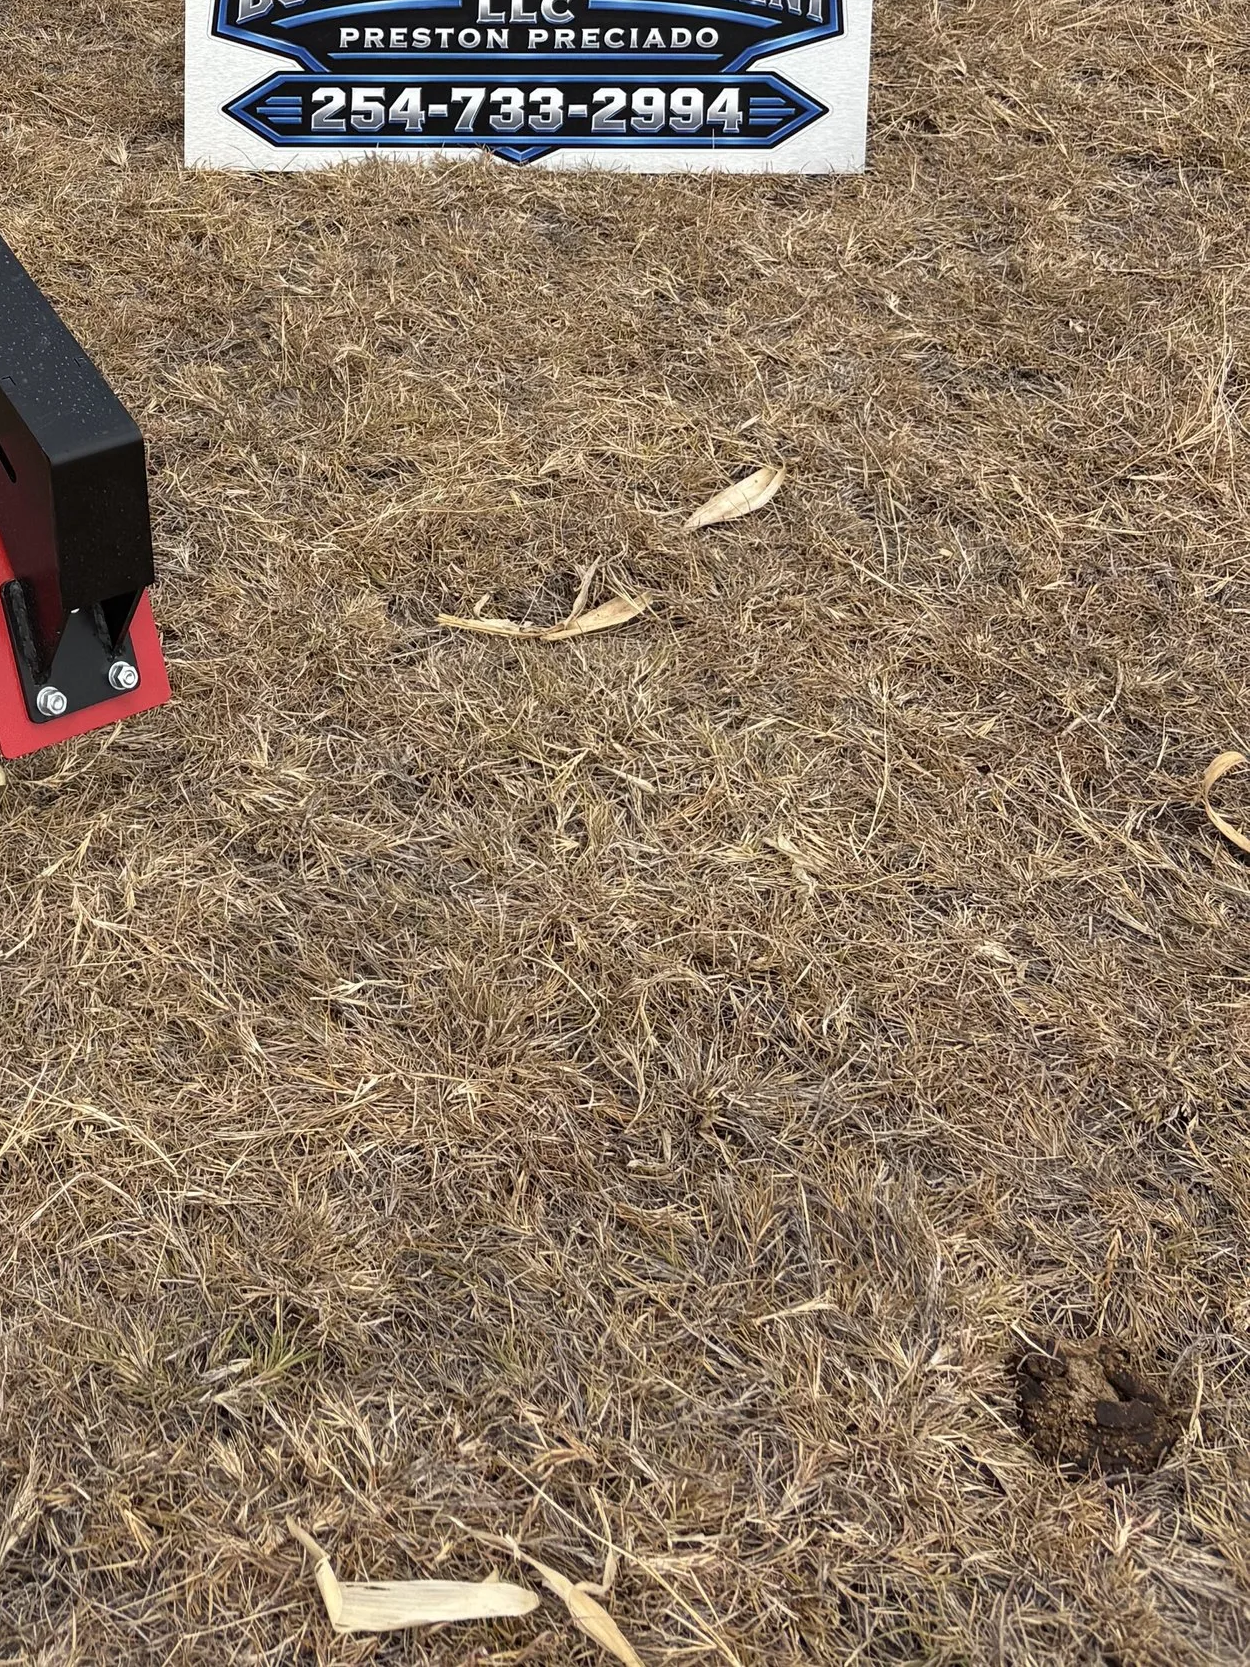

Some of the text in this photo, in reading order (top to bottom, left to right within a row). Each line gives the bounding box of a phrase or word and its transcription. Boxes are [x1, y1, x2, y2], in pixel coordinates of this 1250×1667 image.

[339, 26, 720, 50] PRESTON PRECIADO
[309, 86, 744, 133] 254-733-2994
